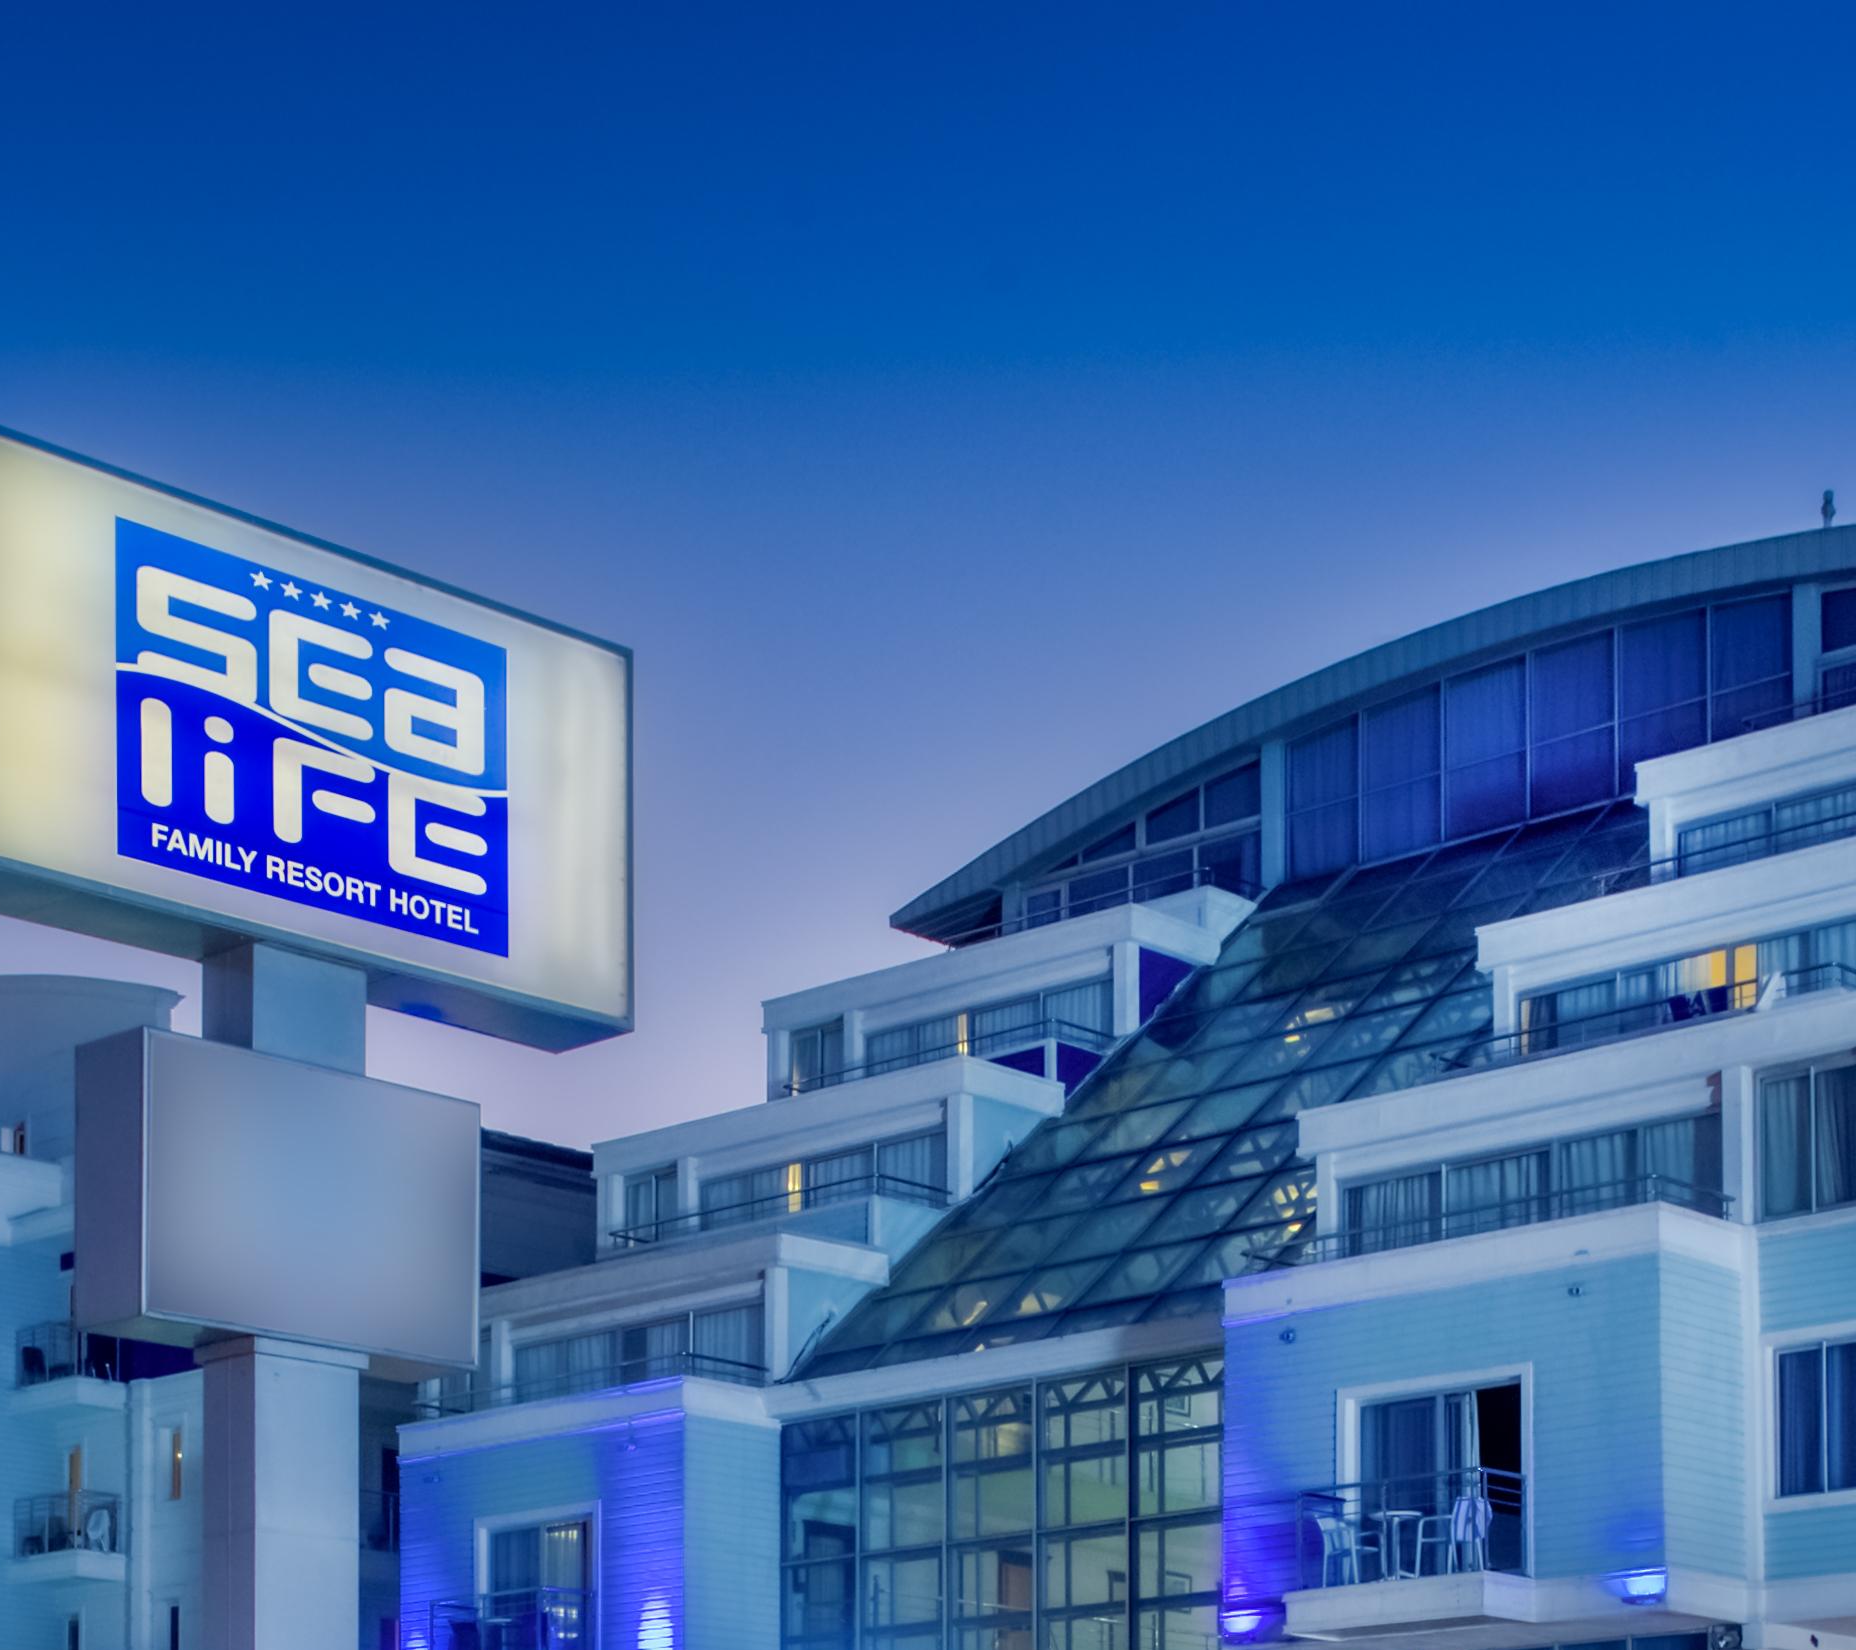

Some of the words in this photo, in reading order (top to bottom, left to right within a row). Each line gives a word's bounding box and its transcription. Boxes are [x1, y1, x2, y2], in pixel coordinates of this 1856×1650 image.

[151, 823, 258, 873] FAMILY
[266, 855, 382, 907] RESORT
[389, 888, 480, 935] HOTEL
